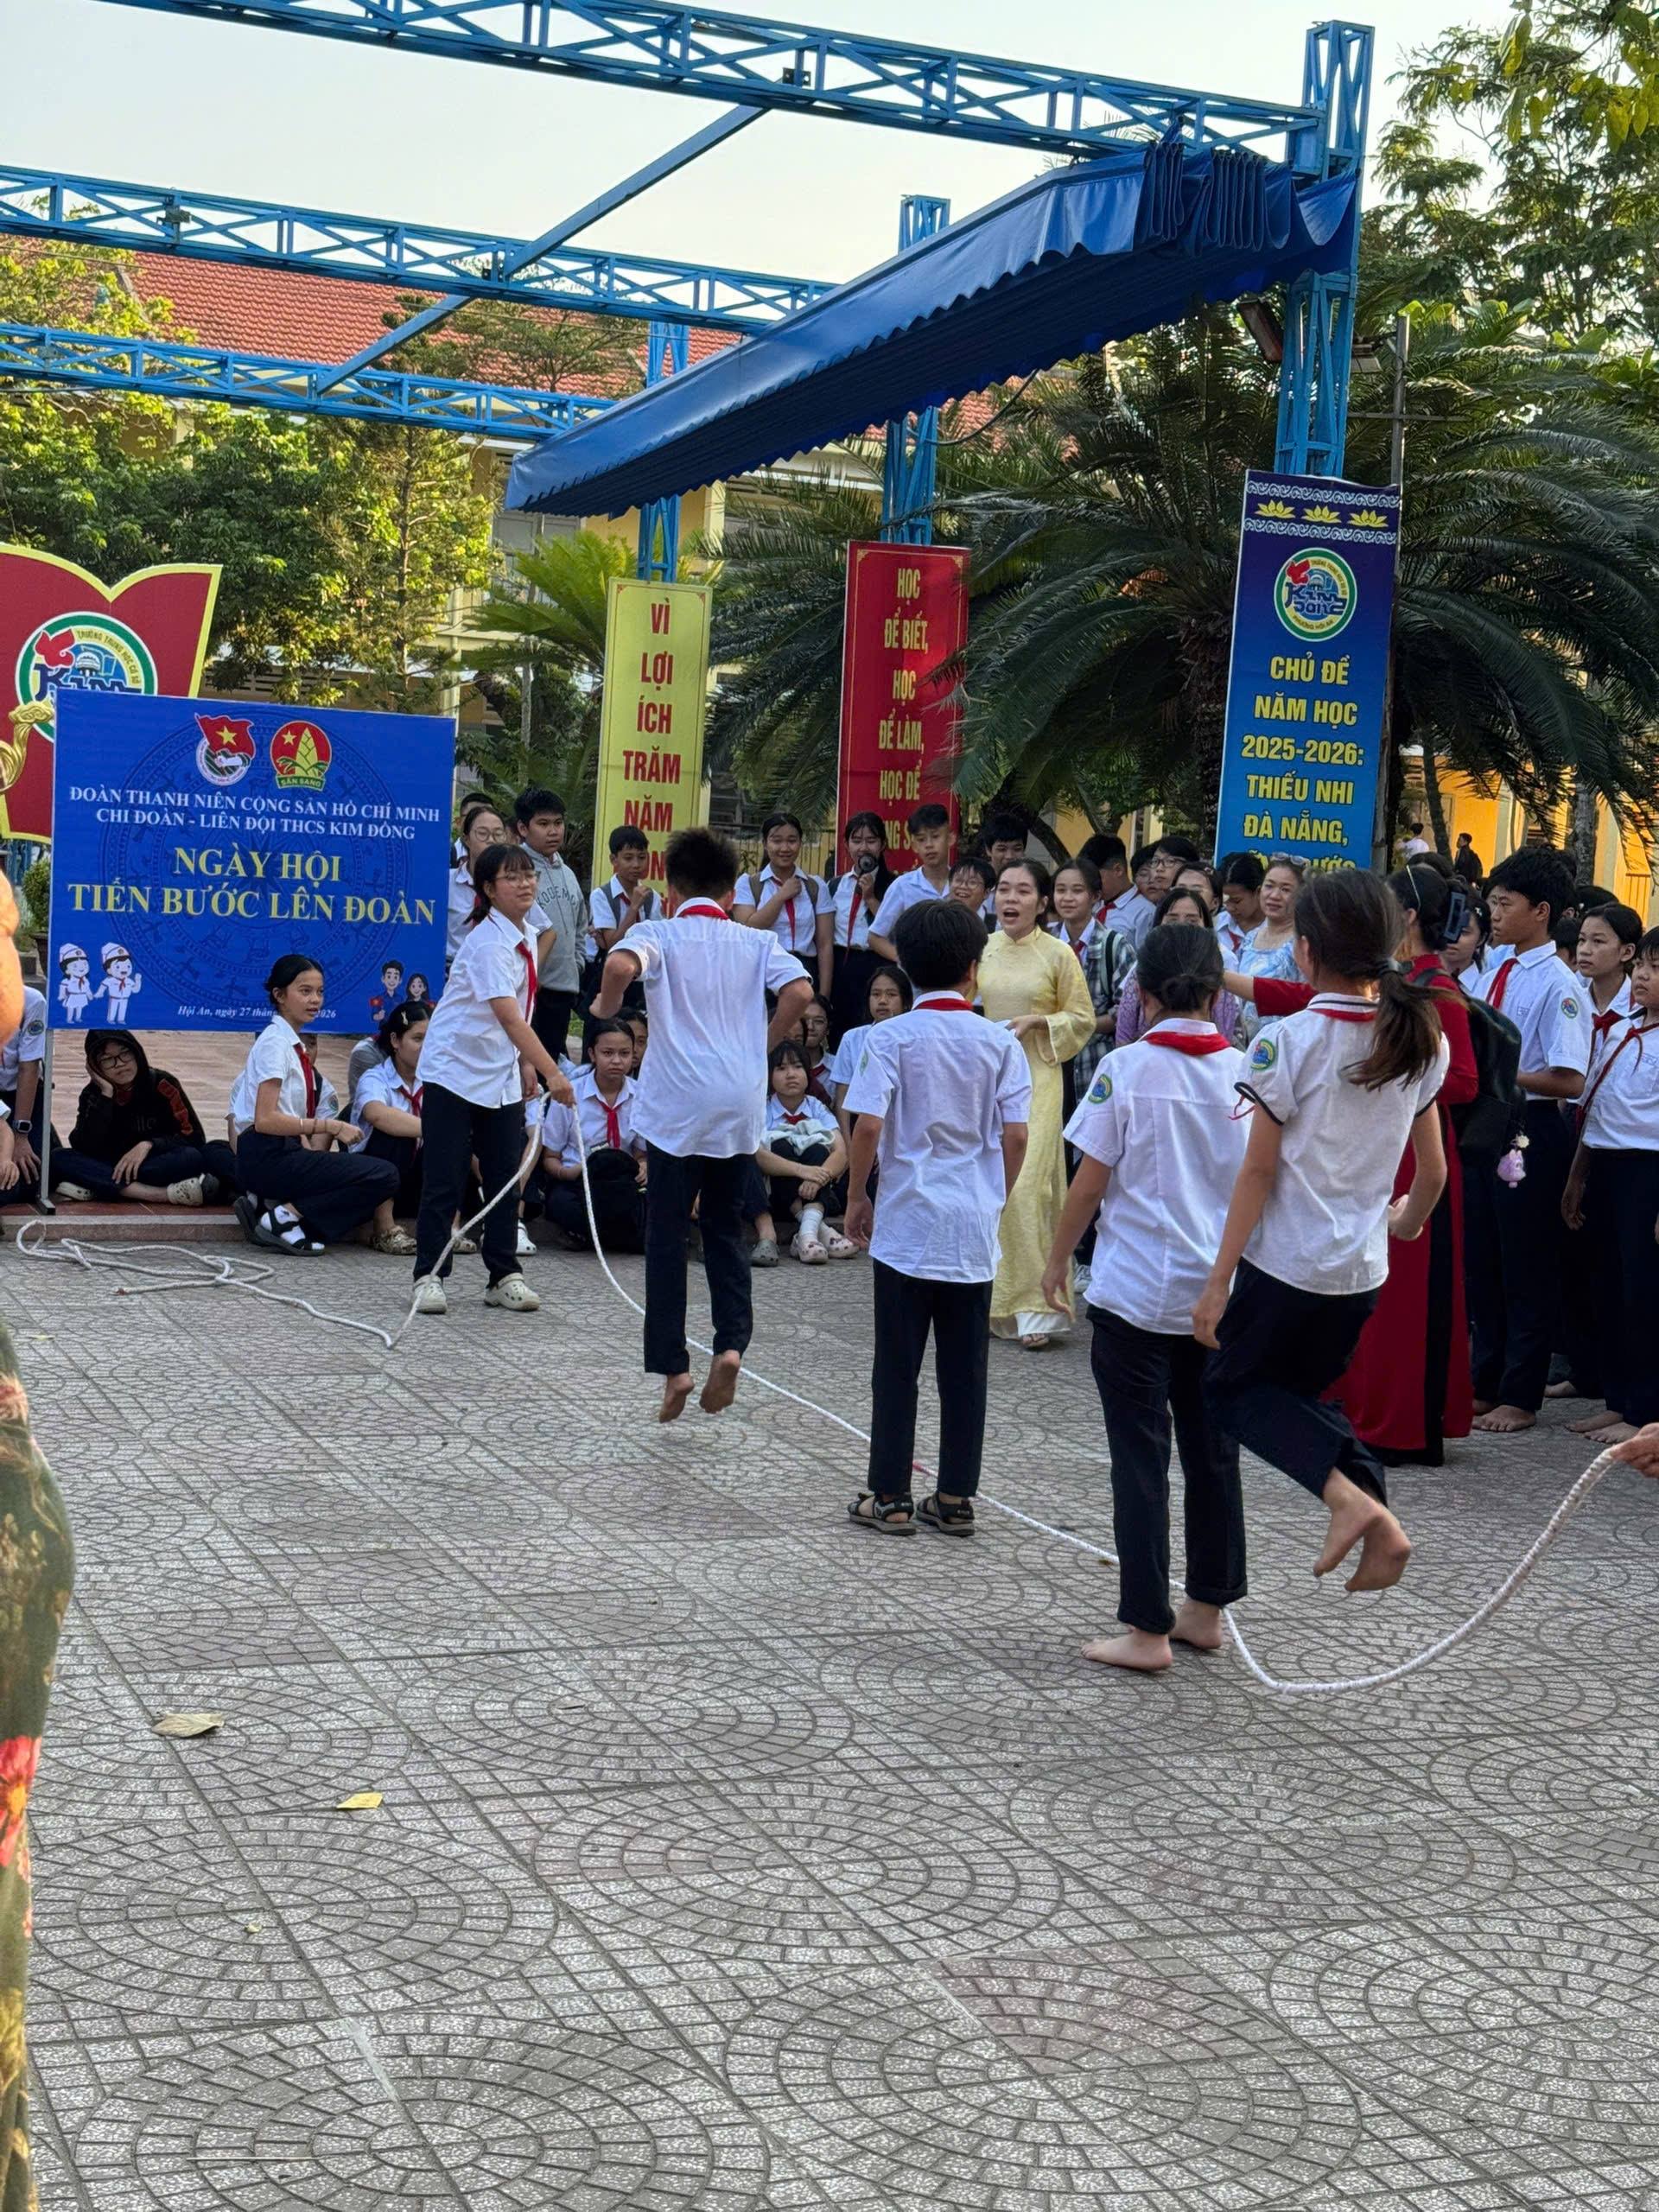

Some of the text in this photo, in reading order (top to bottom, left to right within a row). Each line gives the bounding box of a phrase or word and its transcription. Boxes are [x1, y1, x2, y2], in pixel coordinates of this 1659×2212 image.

[896, 568, 921, 605] HỌC
[651, 597, 671, 635] VÌ
[883, 607, 929, 654] ĐỂ BIẾT,
[640, 651, 673, 690] LỢI
[1270, 651, 1351, 685] CHỦ ĐỀ
[892, 669, 917, 706] HỌC
[637, 695, 672, 734] ÍCH
[1255, 691, 1357, 729] NĂM HỌC
[878, 708, 925, 754] ĐỂ LÀM,
[1241, 734, 1364, 766] 2025-2026:
[622, 746, 681, 784] TRĂM
[879, 760, 922, 807] HỌC ĐỂ
[70, 784, 440, 822] ĐOÀN THANH NIÊN CỘNG SẢN HỒ CHÍ MINH
[1246, 771, 1354, 804] THIẾU NHI
[96, 808, 129, 823] CHI
[135, 808, 185, 826] ĐOÀN
[200, 811, 240, 830] LIÊN
[245, 816, 276, 834] ĐỘI
[280, 818, 325, 834] THCS
[330, 822, 363, 836] KIM
[367, 821, 415, 840] ĐỒNG
[623, 794, 673, 832] NĂM
[1243, 810, 1348, 846] ĐÀ NẴNG,
[174, 842, 342, 888] NGÀY HỘI
[67, 877, 435, 927] TIẾN BƯỚC LÊN ĐOÀN
[177, 1005, 196, 1017] Hội
[196, 1007, 213, 1017] An,
[215, 1007, 236, 1018] ngày
[239, 1007, 251, 1017] 27
